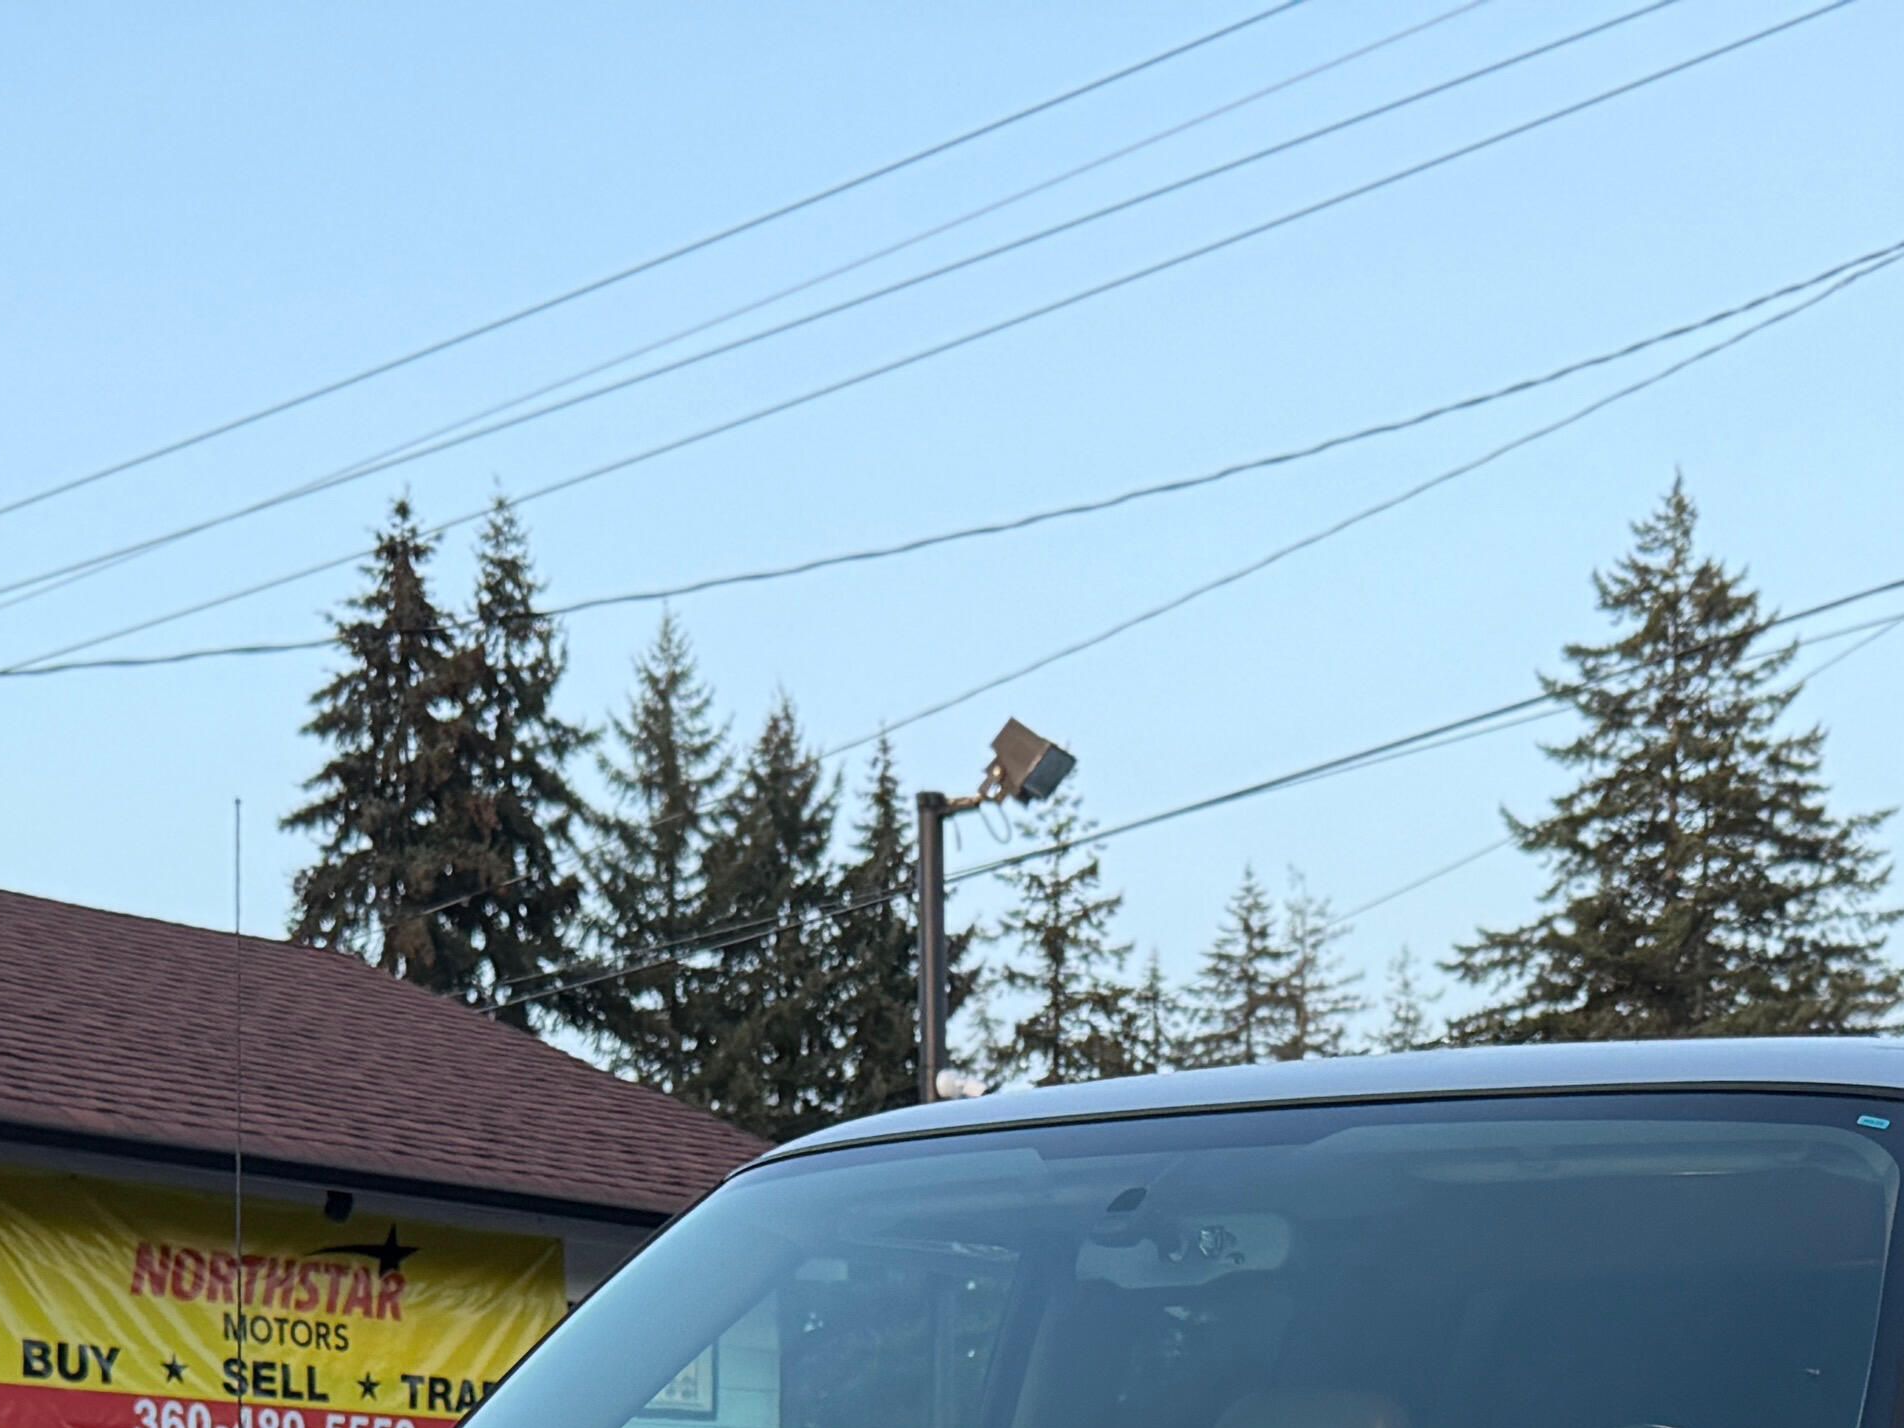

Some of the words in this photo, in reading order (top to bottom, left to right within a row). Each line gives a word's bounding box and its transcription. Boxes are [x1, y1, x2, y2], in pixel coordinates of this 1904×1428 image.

[130, 1241, 408, 1321] NORTHSTAR
[223, 1312, 349, 1352] MOTORS
[22, 1339, 120, 1385] BUY
[222, 1357, 329, 1402] SELL
